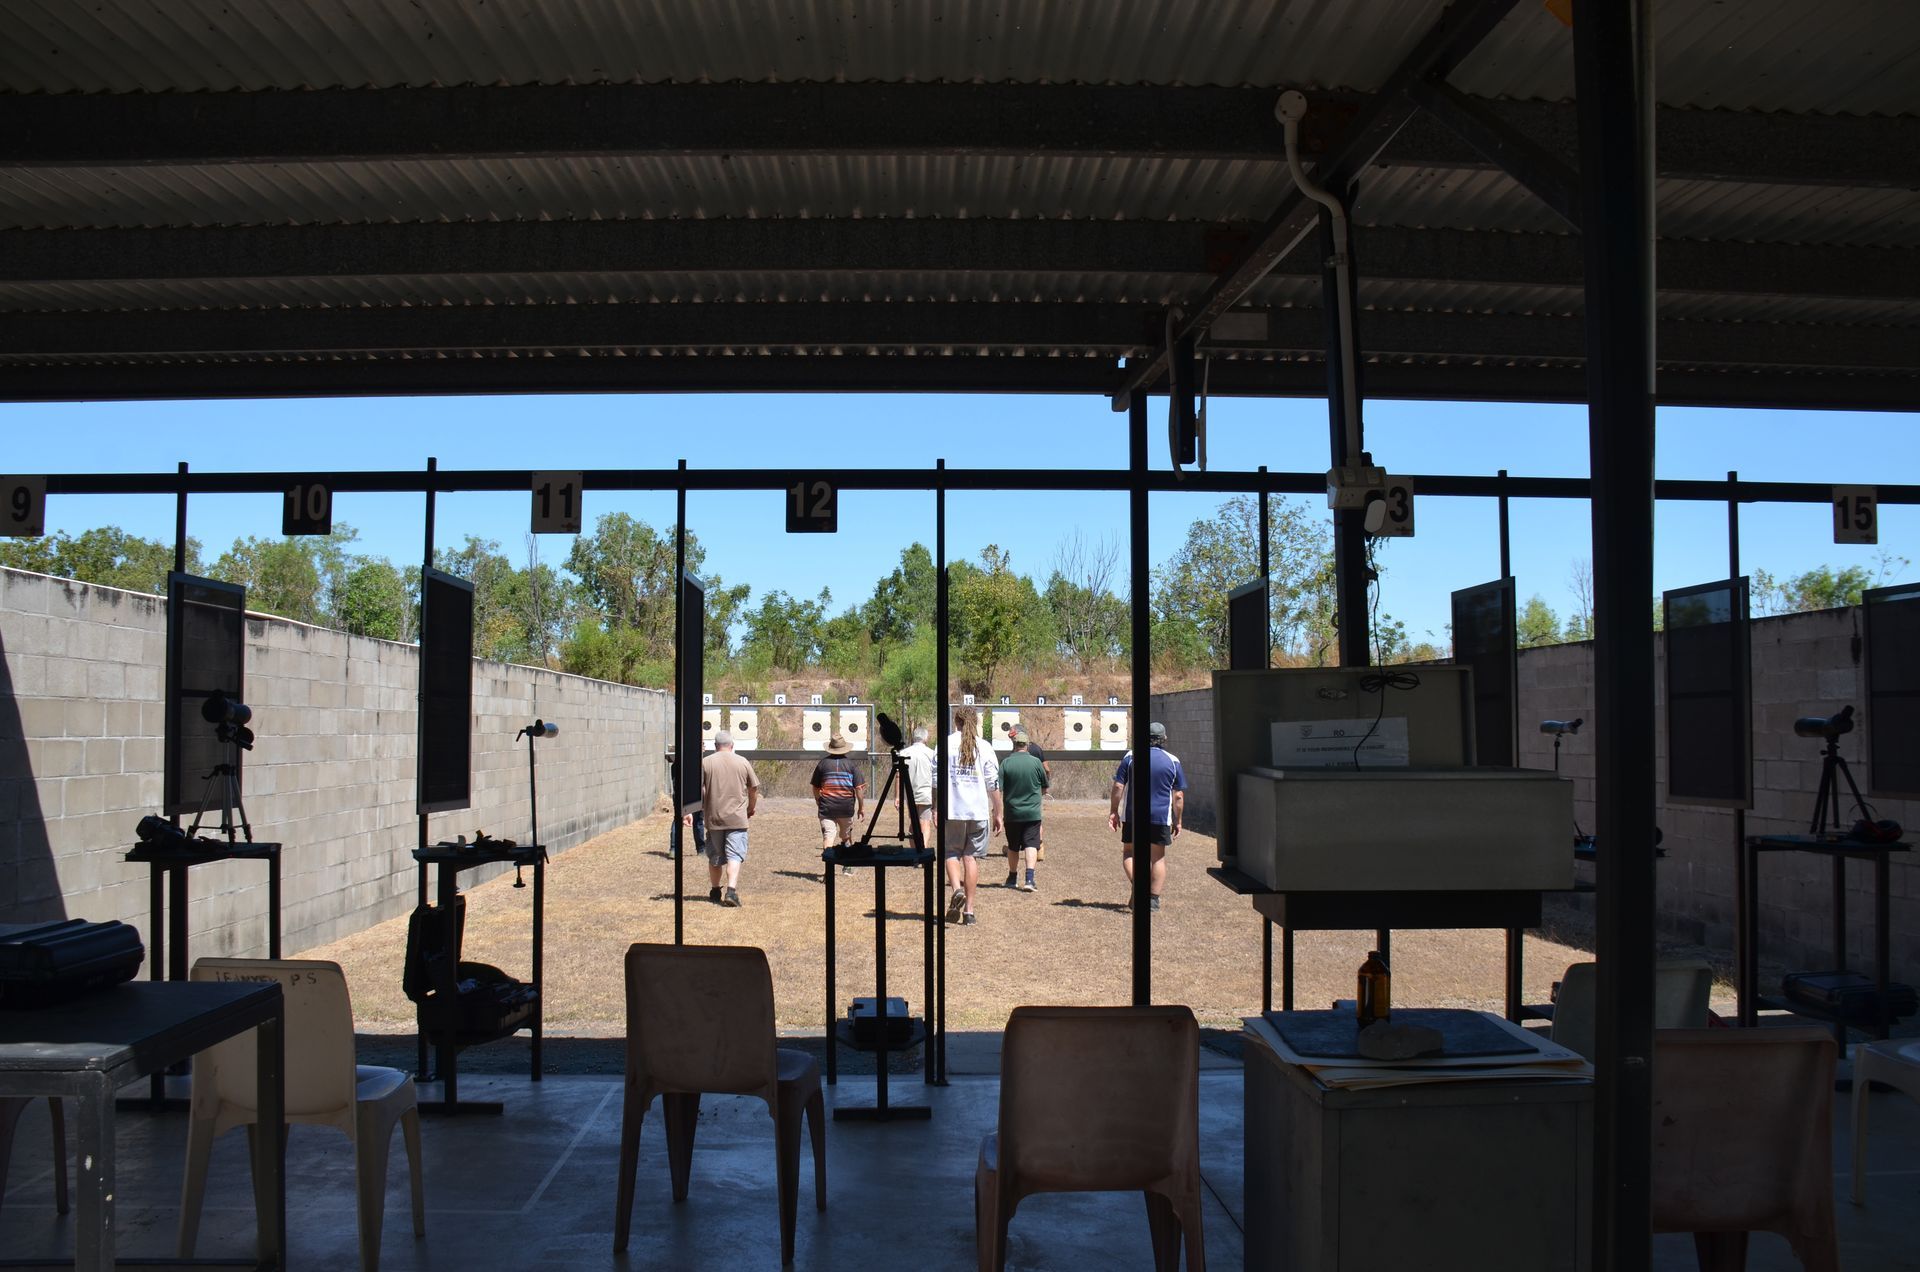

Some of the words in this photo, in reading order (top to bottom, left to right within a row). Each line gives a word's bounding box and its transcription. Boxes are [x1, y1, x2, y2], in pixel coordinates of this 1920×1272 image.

[11, 486, 31, 522] 9
[288, 483, 328, 521] 10
[537, 483, 573, 518] 11
[790, 480, 832, 518] 12
[1389, 486, 1409, 523] 3
[1837, 496, 1873, 530] 15
[704, 696, 710, 704] 9
[739, 696, 749, 704] 10
[965, 697, 974, 705] 13
[1001, 697, 1010, 705] 14
[1073, 697, 1082, 705] 15
[1108, 697, 1118, 705] 16
